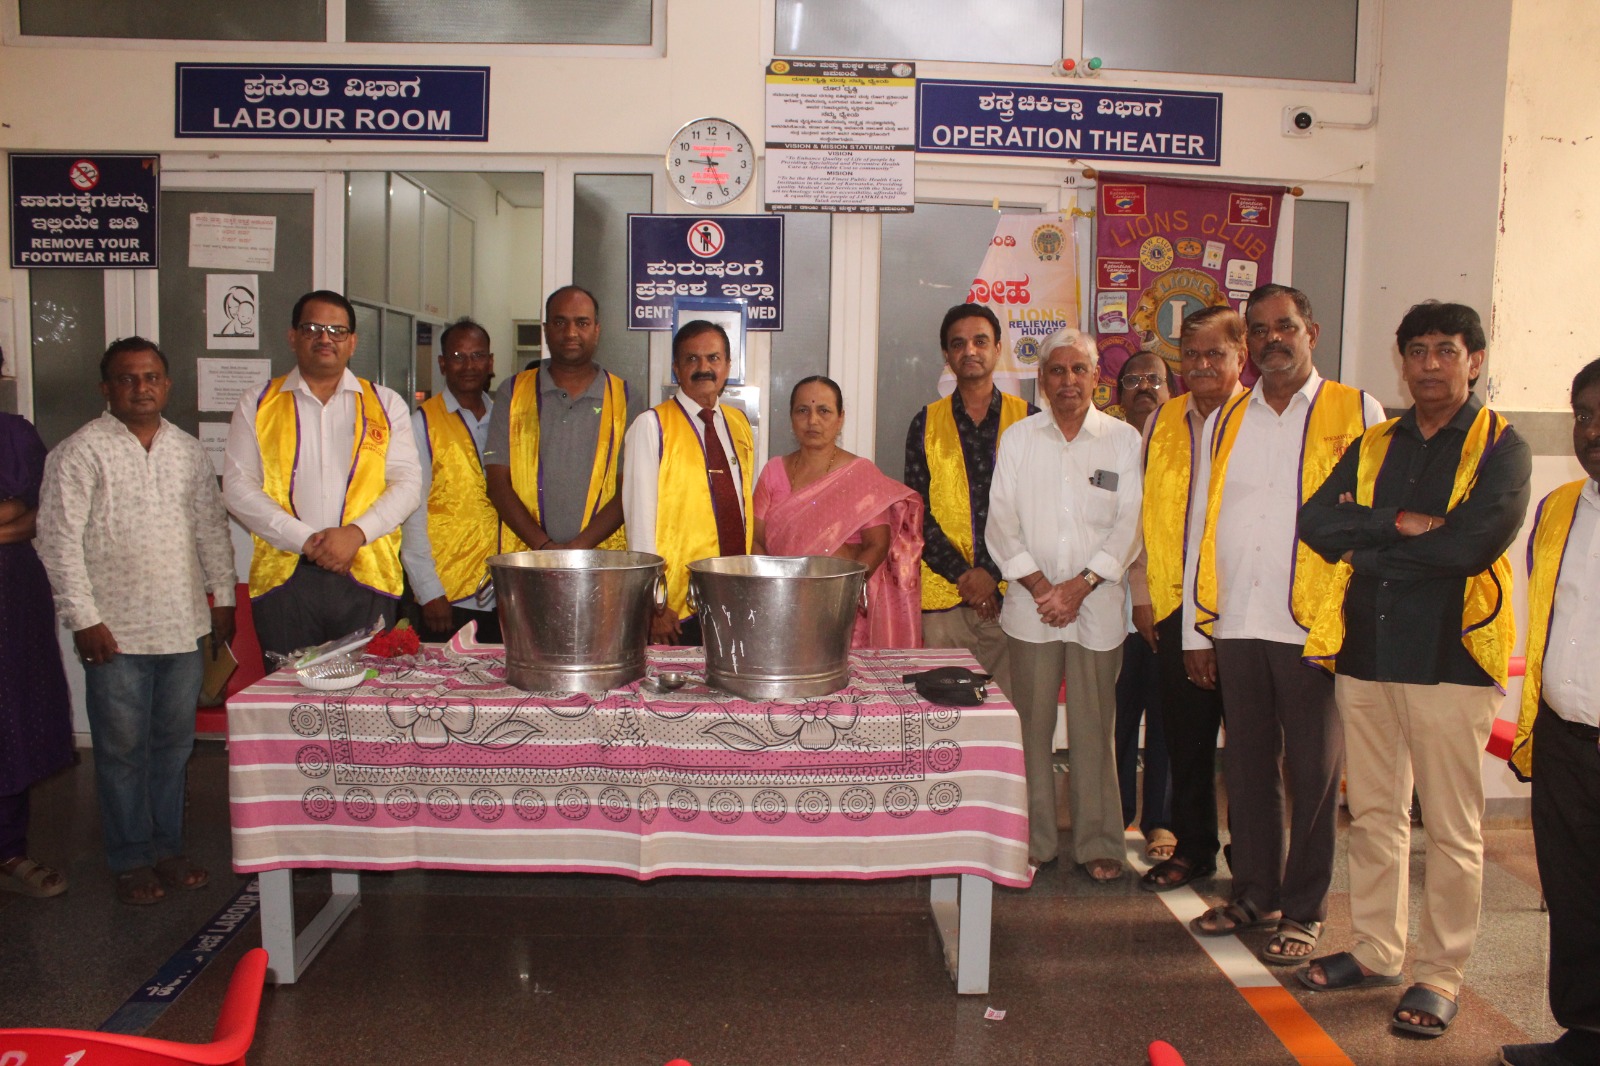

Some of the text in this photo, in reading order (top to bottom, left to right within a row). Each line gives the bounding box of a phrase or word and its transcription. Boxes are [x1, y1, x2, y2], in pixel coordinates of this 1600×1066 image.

[244, 74, 421, 103] ಪ್ರಸೂತಿ ವಿಭಾಗ
[1096, 98, 1162, 118] ವಿಭಾಗ
[213, 107, 450, 130] LABOUR ROOM
[692, 131, 700, 139] 11
[707, 127, 717, 135] 12
[932, 124, 1205, 156] OPERATION THEATER
[680, 143, 690, 151] 10
[737, 144, 743, 152] 2
[679, 175, 685, 184] 8
[735, 176, 741, 184] 4
[1064, 176, 1075, 185] 40
[691, 186, 697, 195] 7
[724, 188, 729, 196] 5
[20, 192, 148, 214] ಪಾದರಕ್ಷೆಗಳನ್ನು
[31, 214, 139, 234] ಇಲ್ಲಿಯೇ ಬಿಡಿ
[1111, 210, 1267, 260] LIONS CLUB
[32, 238, 140, 248] REMOVE YOUR
[1141, 237, 1172, 255] NEW CLUB
[21, 252, 150, 262] FOOTWEAR HEAR
[1142, 256, 1172, 270] SPONSOR
[646, 260, 764, 278] ಪುರುಷರಿಗೆ
[636, 280, 774, 301] ಪ್ರವೇಶ ಇಲ್ಲಾ
[1160, 274, 1212, 297] LIONS
[635, 306, 673, 319] GENT
[1008, 309, 1067, 322] LIONS
[1009, 320, 1067, 329] RELIEVING
[1025, 345, 1033, 354] L
[208, 894, 260, 933] LABOUR
